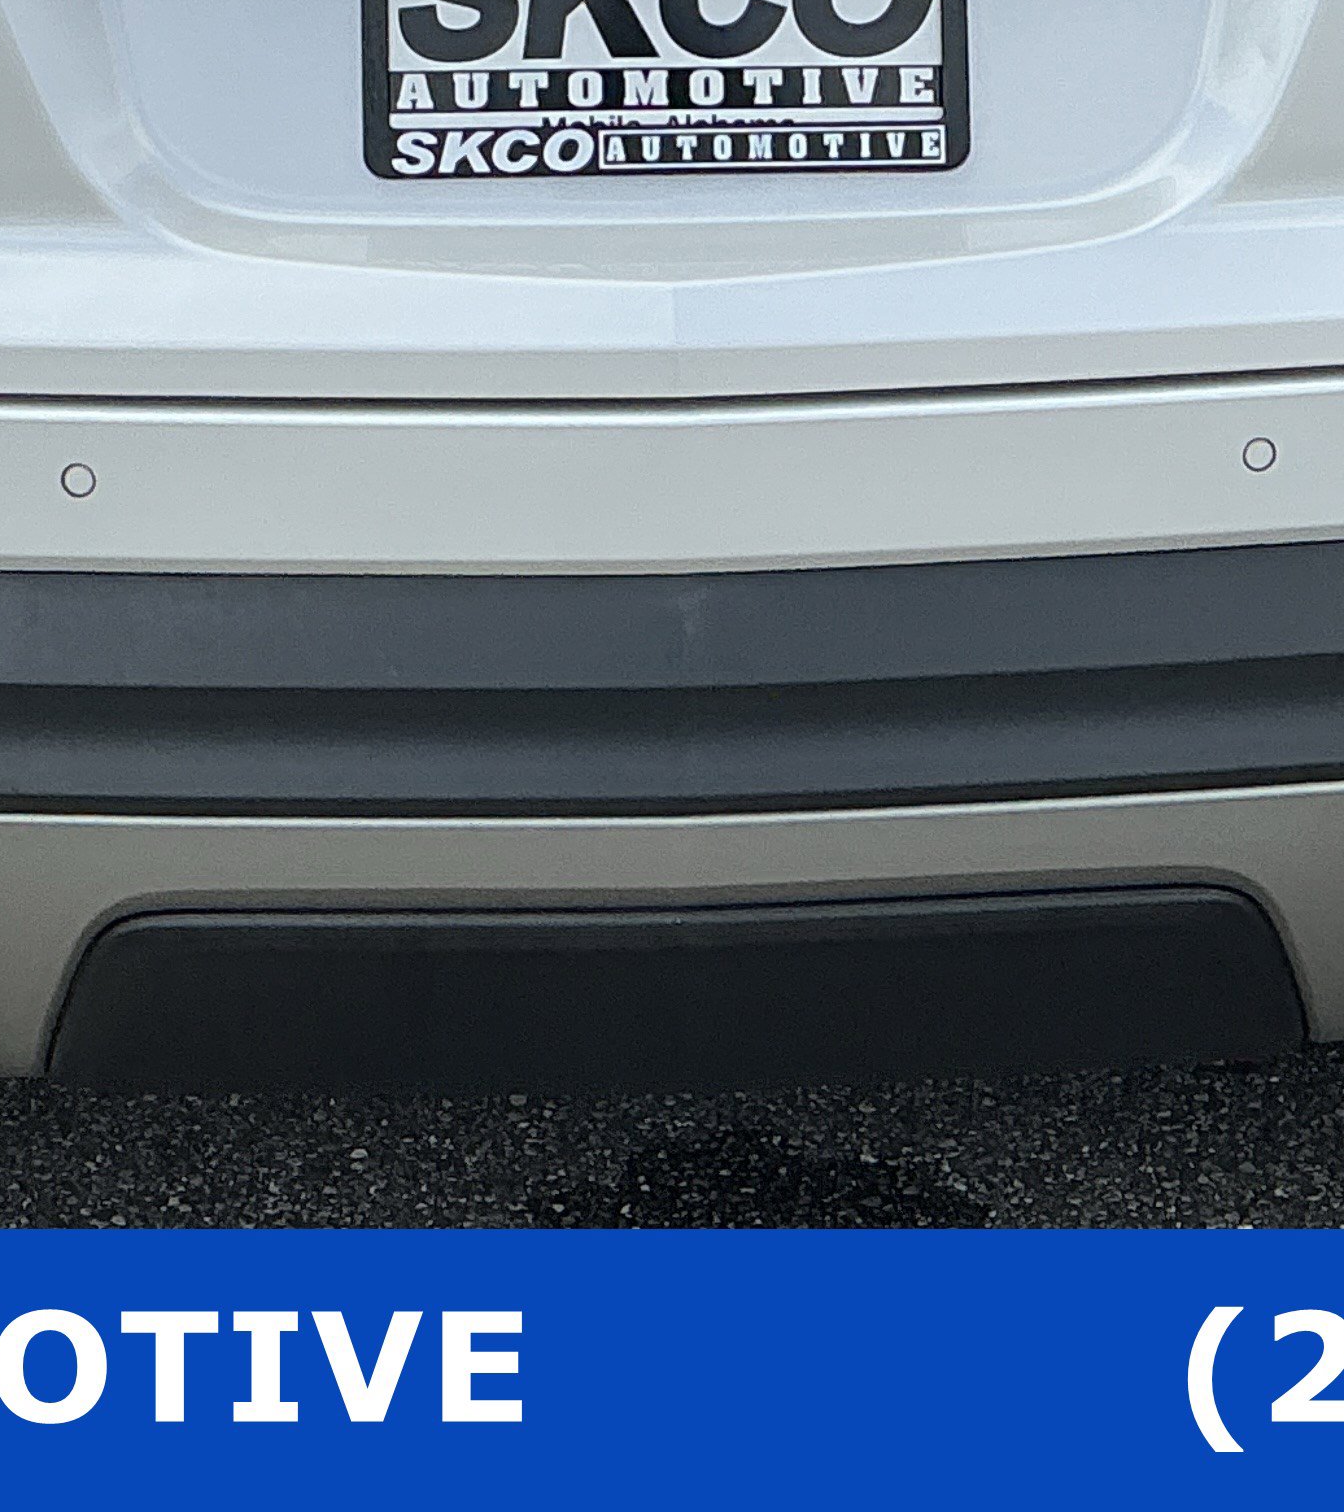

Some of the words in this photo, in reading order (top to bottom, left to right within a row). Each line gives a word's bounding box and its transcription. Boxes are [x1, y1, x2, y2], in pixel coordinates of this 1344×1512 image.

[396, 67, 936, 110] AUTOMOTIVE
[391, 129, 595, 175] SKCO
[606, 131, 941, 162] AUTOMOTIVE
